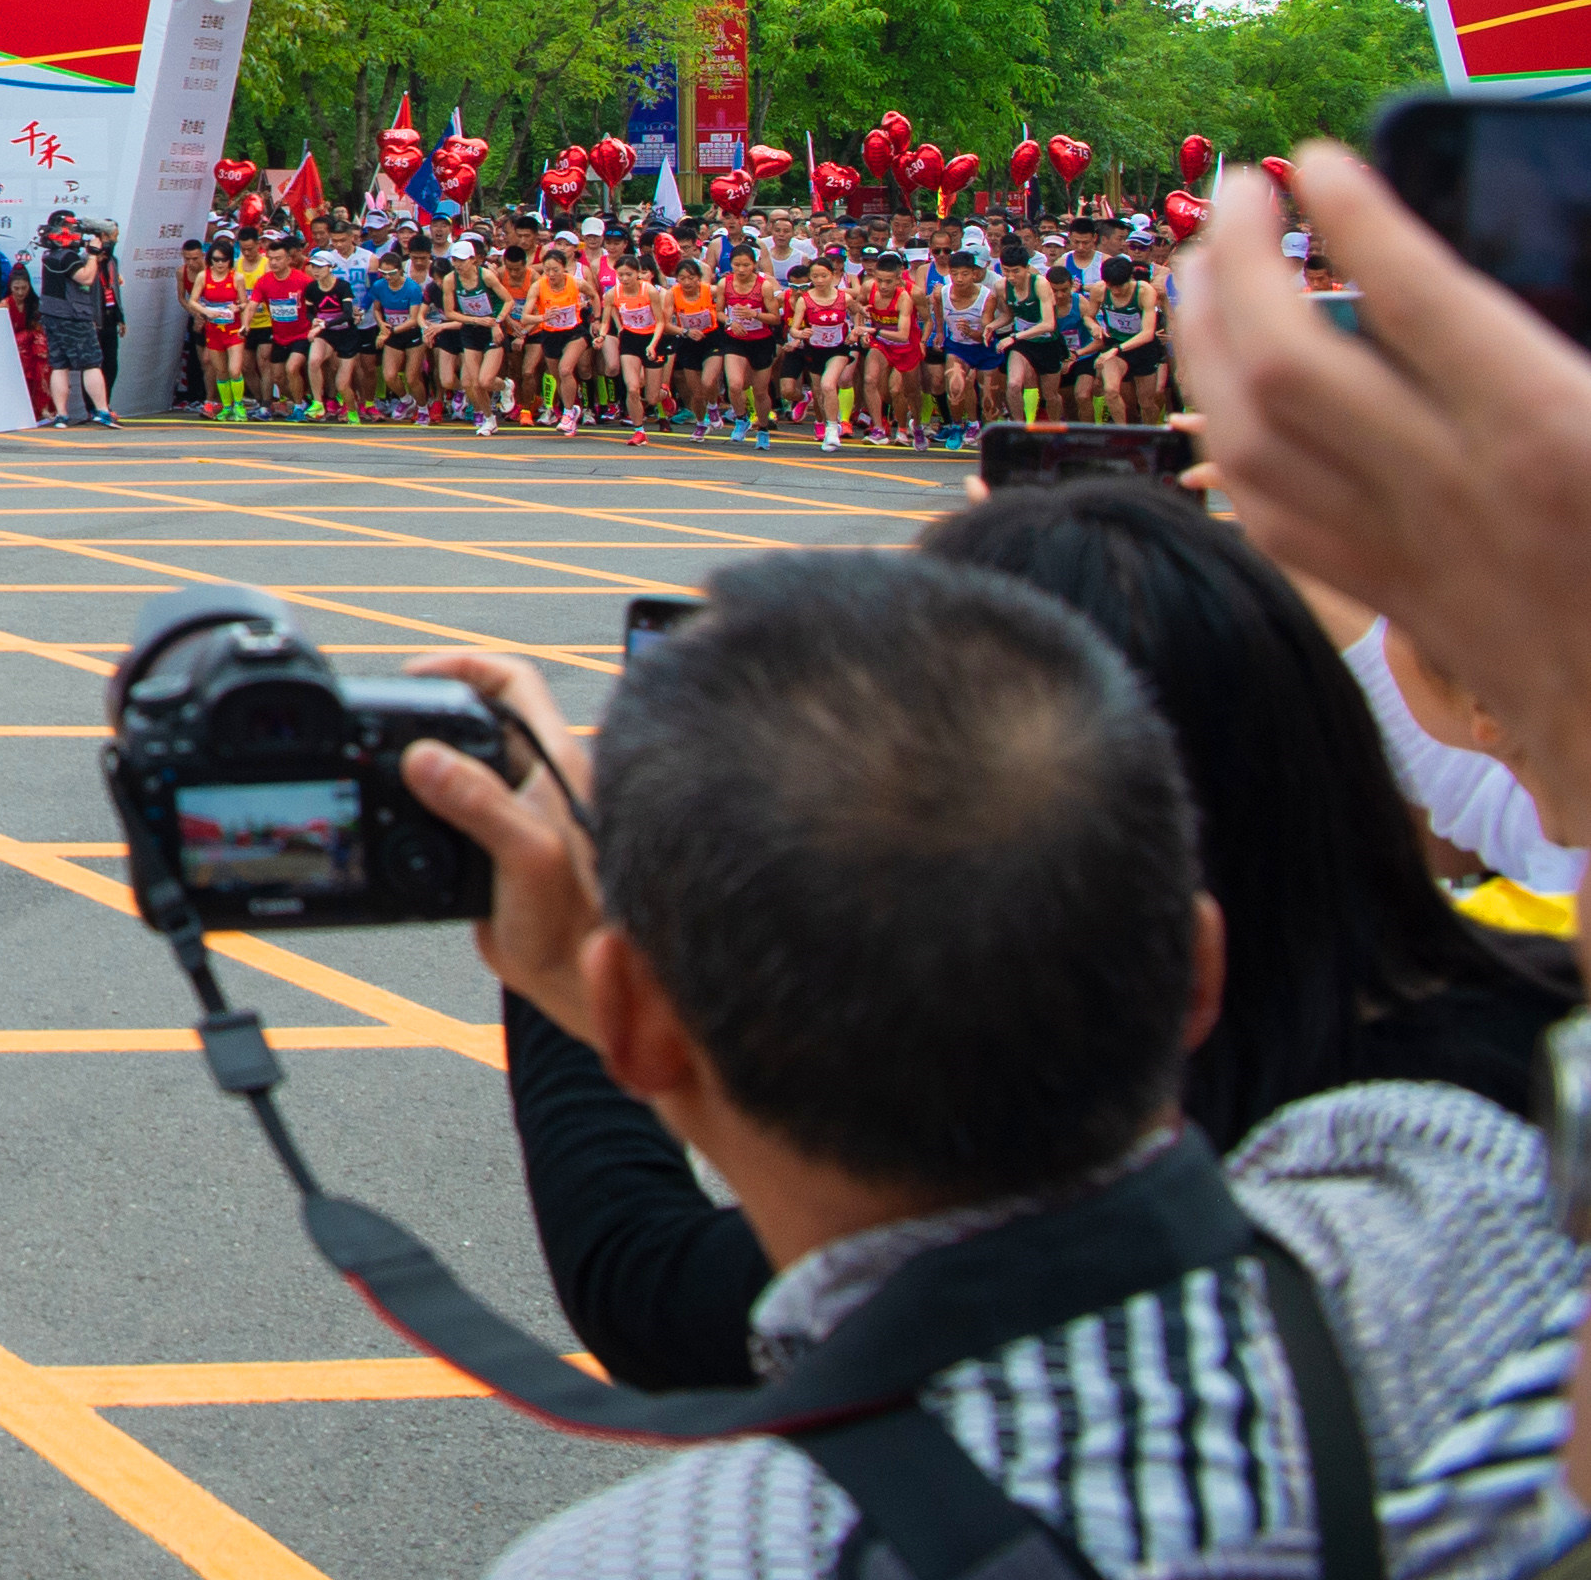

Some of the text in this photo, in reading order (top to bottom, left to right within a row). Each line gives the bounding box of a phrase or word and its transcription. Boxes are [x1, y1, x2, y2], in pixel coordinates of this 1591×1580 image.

[9, 120, 76, 170] 千禾
[454, 142, 481, 157] 2:45
[1065, 142, 1090, 160] 2:15
[384, 156, 410, 169] 2:45
[218, 168, 243, 181] 3:00
[549, 182, 578, 196] 3:00
[826, 175, 852, 191] 2:15
[726, 182, 751, 201] 2:15
[1178, 201, 1209, 221] 1:45
